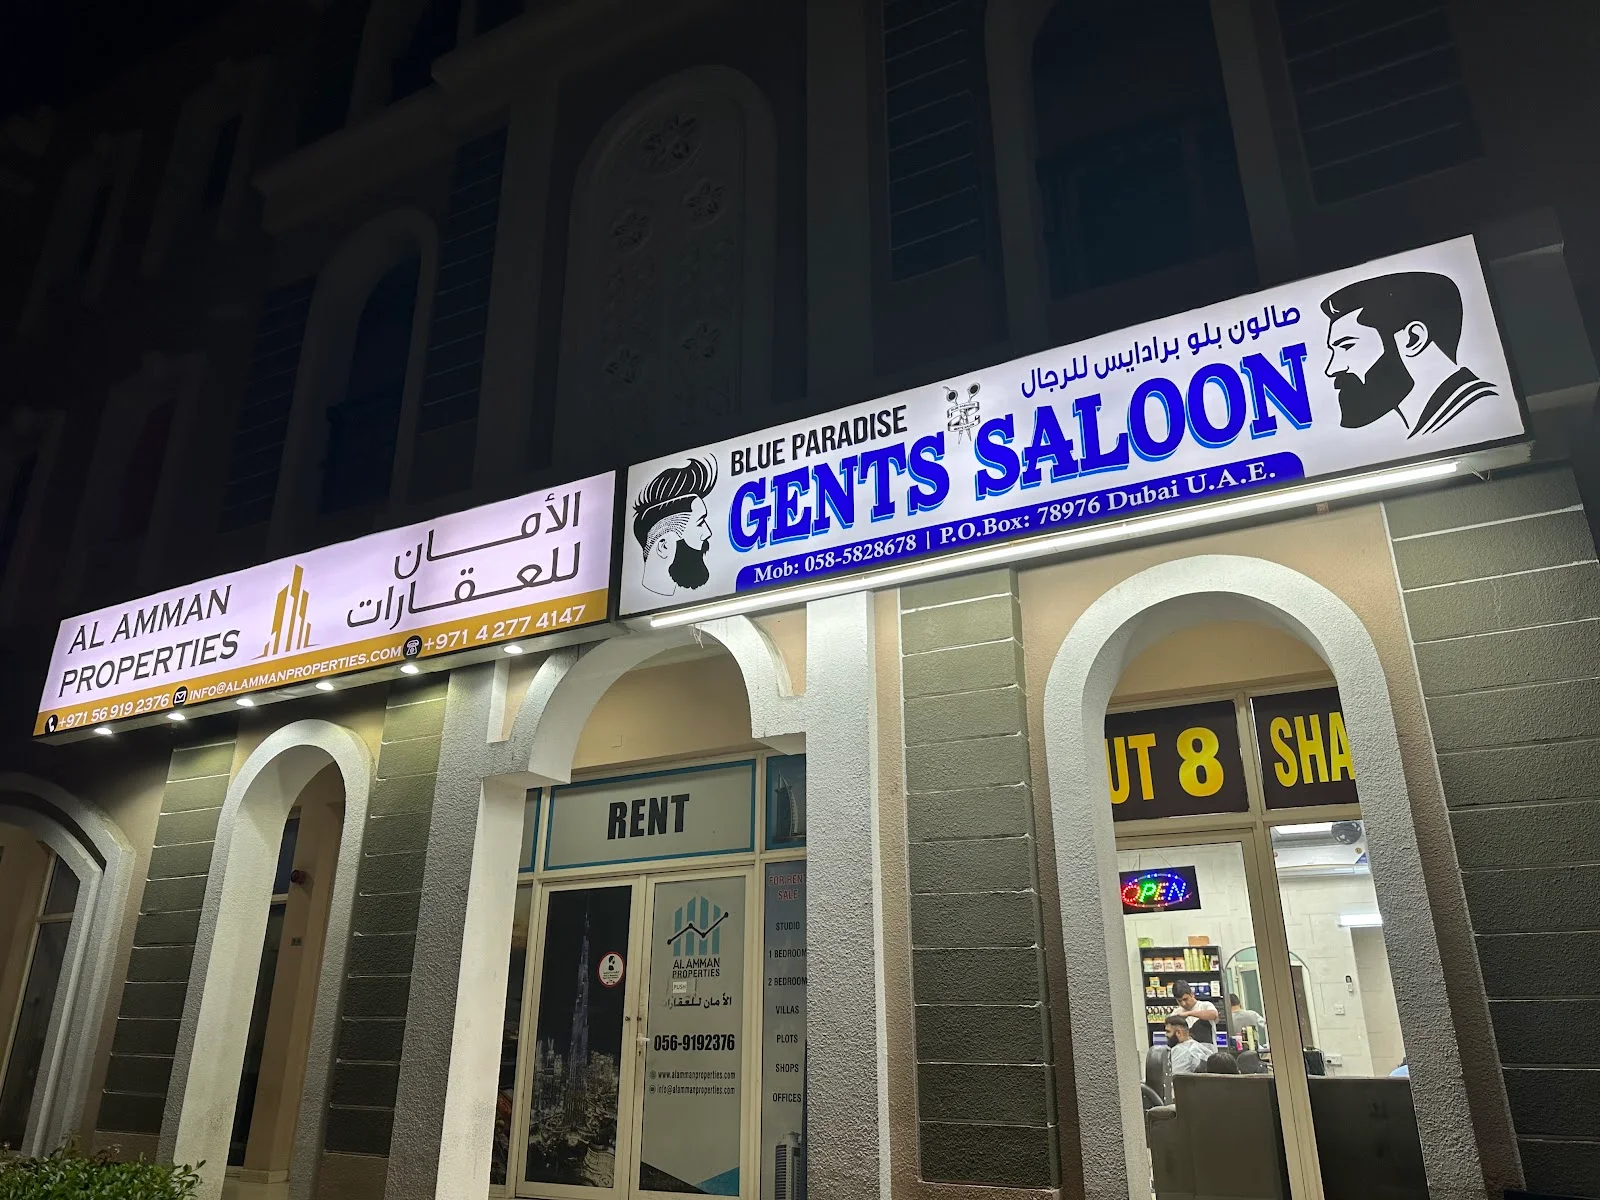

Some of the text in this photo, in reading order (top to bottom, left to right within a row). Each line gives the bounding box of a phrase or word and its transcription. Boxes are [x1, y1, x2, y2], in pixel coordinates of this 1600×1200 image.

[1021, 304, 1301, 398] صالون بلو برادايس للرجال
[731, 404, 908, 477] BLUE PARADISE
[728, 342, 1313, 553] GENTS SALOON
[753, 562, 800, 584] Mob:
[804, 534, 917, 573] 058-5828678
[939, 515, 1030, 545] P.O.Box:
[1037, 500, 1101, 526] 78976
[1108, 481, 1180, 511] Dubai
[1184, 462, 1277, 494] U.A.E.
[67, 585, 233, 655] AL AMMAN
[58, 629, 241, 699] PROPERTIES
[59, 604, 586, 728] +971 56 919 2376 INFO@ALAMMANPROPERTIES.COM +971 4 277 4147
[1175, 726, 1226, 798] 8
[1270, 711, 1355, 788] SHA
[607, 794, 690, 841] RENT
[769, 876, 786, 886] FOR
[778, 890, 798, 900] SALE
[1122, 882, 1188, 904] OPEN
[775, 921, 801, 931] STUDIO
[769, 950, 772, 958] 1
[672, 958, 720, 969] AL AMMAN
[672, 968, 720, 979] PROPERTIES
[768, 978, 773, 986] 2
[775, 1005, 800, 1015] VILLAS
[653, 1034, 735, 1051] 056-9192376
[776, 1034, 799, 1044] PLOTS
[775, 1063, 799, 1073] SHOPS
[658, 1070, 736, 1080] www.alammanproperties.com
[657, 1085, 736, 1095] info@alammanproperties.com
[772, 1092, 802, 1103] OFFICES
